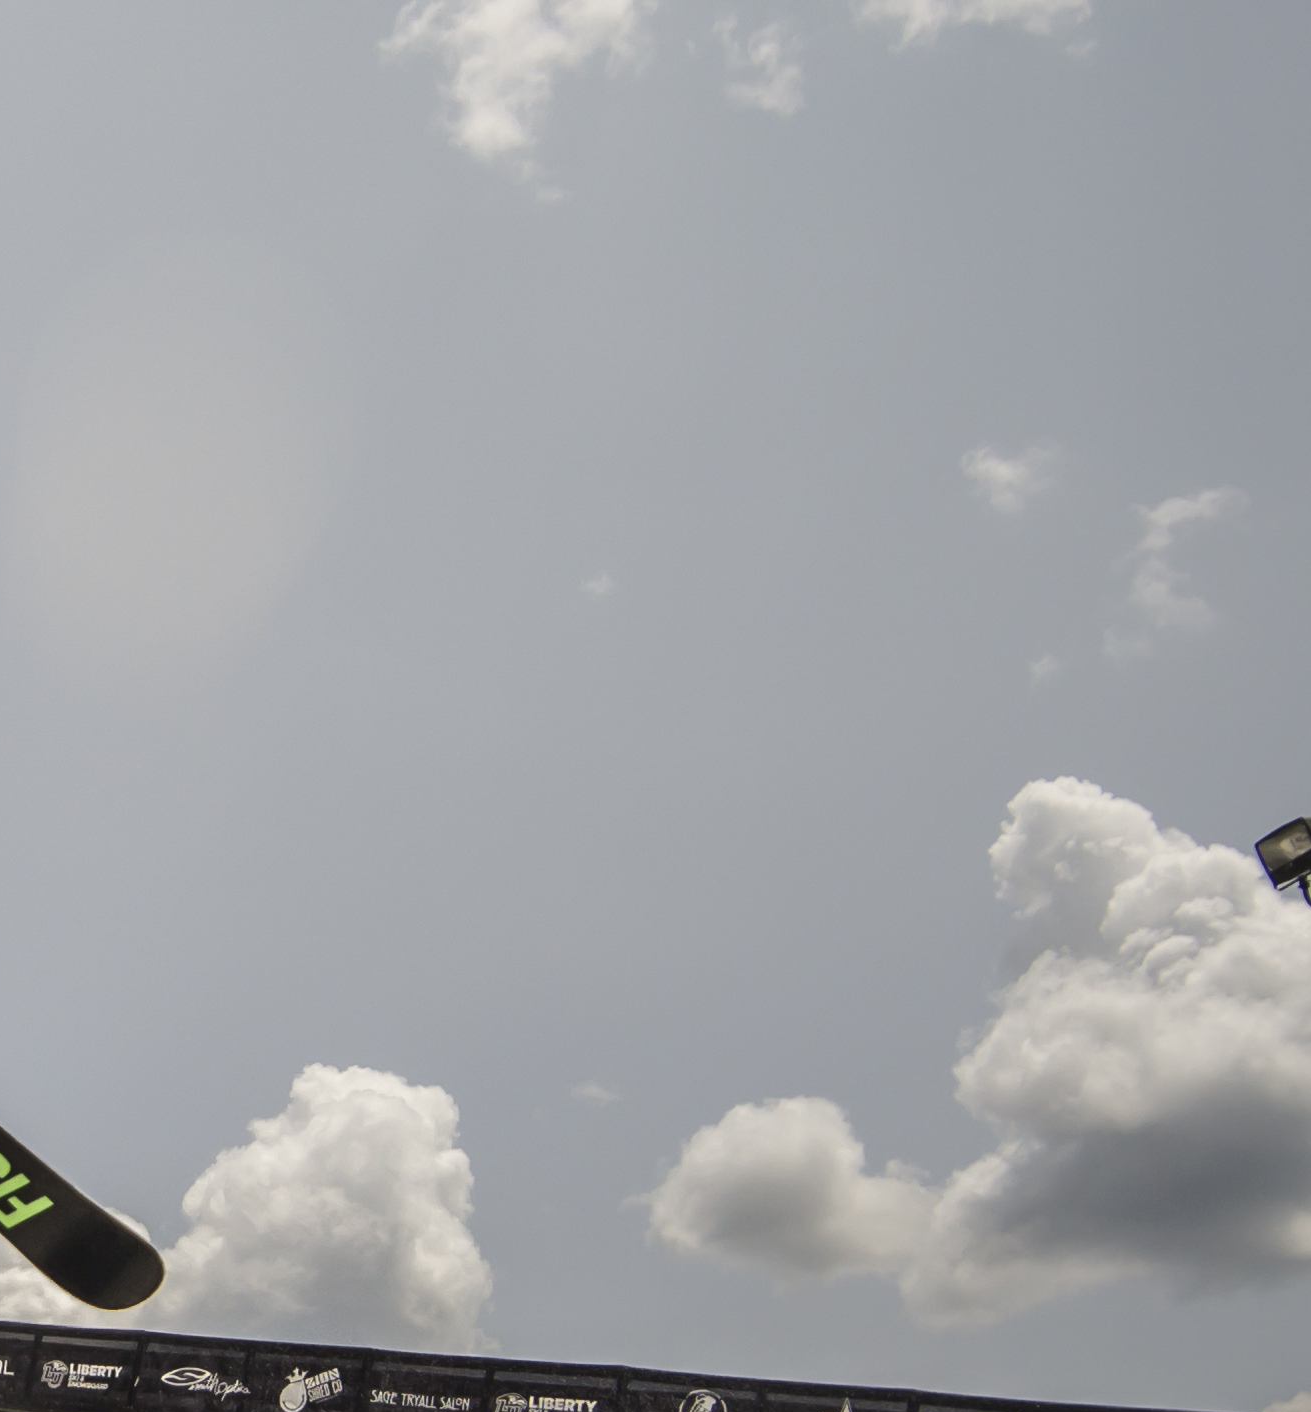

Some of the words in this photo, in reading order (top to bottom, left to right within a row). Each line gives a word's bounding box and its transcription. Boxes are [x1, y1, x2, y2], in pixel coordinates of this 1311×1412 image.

[69, 1362, 123, 1378] LIBERTY
[305, 1367, 339, 1390] ZION
[400, 1393, 437, 1410] TRYALL
[528, 1395, 598, 1412] LIBERTY
